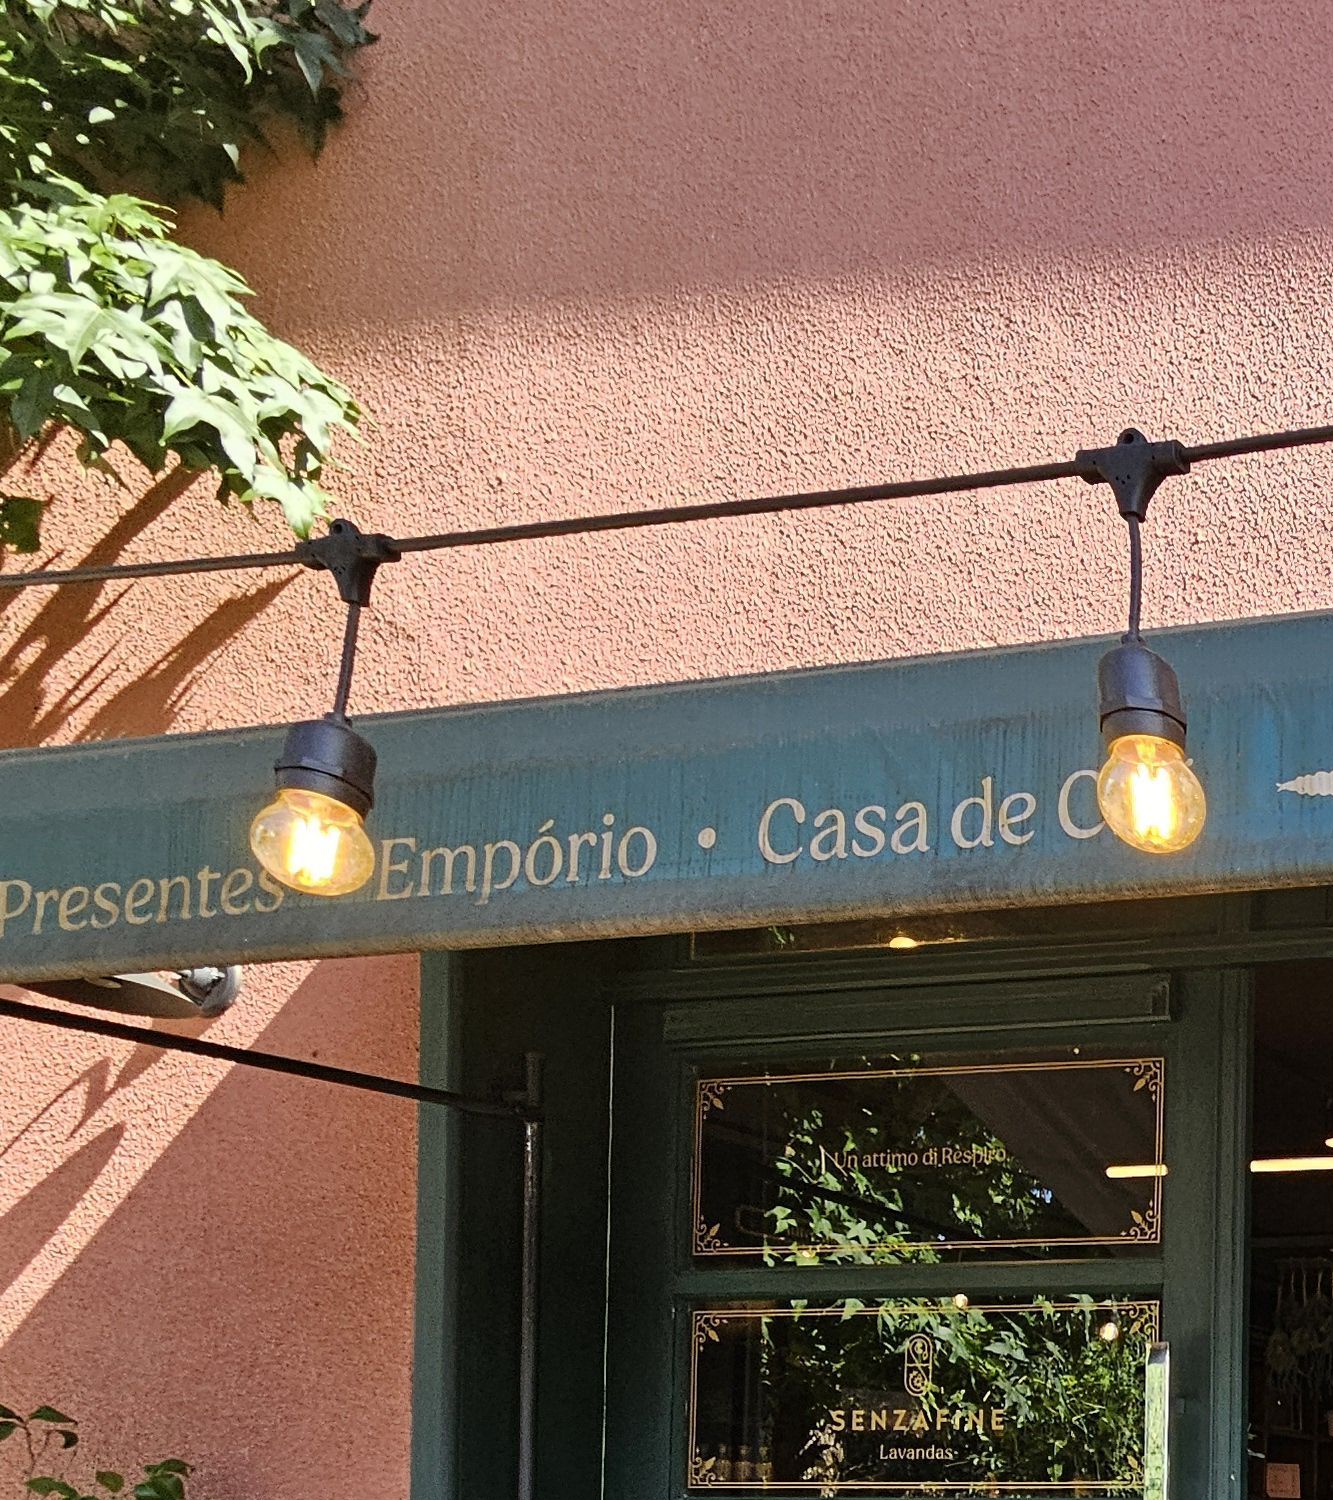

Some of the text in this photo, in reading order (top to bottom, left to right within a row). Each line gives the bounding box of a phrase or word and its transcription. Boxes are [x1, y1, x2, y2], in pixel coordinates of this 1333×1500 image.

[0, 865, 285, 937] Presentes
[376, 814, 658, 906] Empório
[758, 797, 930, 864] Casa
[951, 776, 1037, 849] de
[861, 1150, 918, 1168] attimo
[832, 1409, 1005, 1432] SENZAFINE
[879, 1443, 955, 1461] Lavandas
